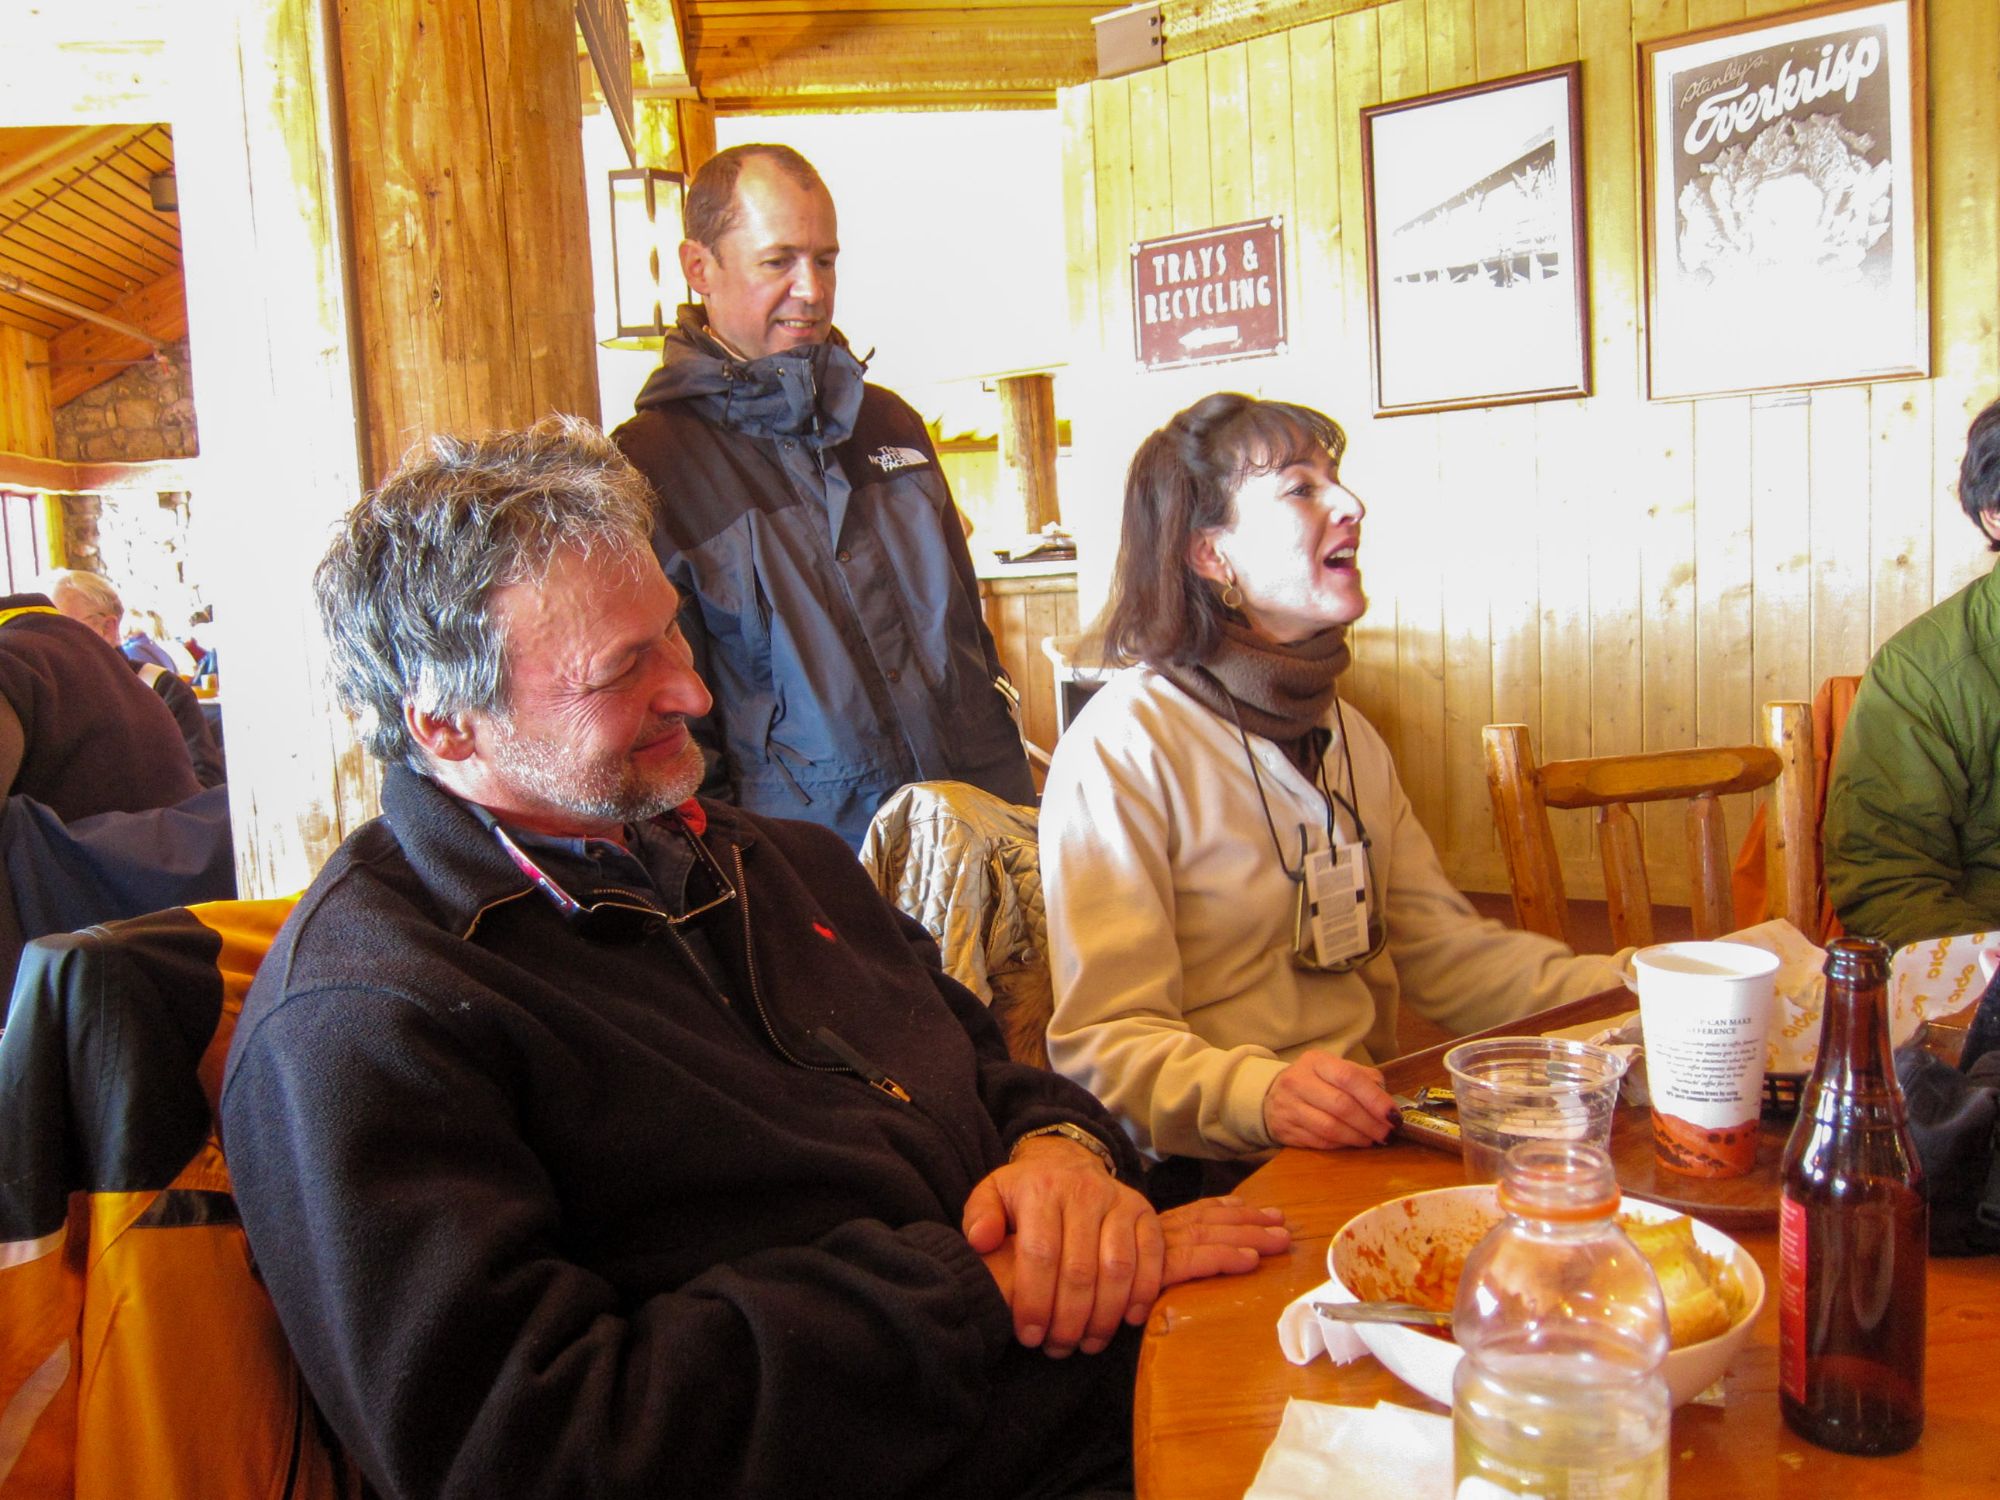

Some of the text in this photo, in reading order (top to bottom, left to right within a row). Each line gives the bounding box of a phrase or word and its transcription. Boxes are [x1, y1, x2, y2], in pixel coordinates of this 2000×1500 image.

[1681, 54, 1769, 109] Stanley's
[1684, 36, 1880, 154] Everkrisp
[1152, 239, 1259, 286] TRAYS &
[1144, 275, 1272, 324] RECYCLING
[878, 446, 899, 455] THE
[868, 452, 904, 464] NORTH
[881, 458, 910, 472] FACE
[1729, 1017, 1752, 1025] MAKE
[1687, 1027, 1737, 1035] FERENCE
